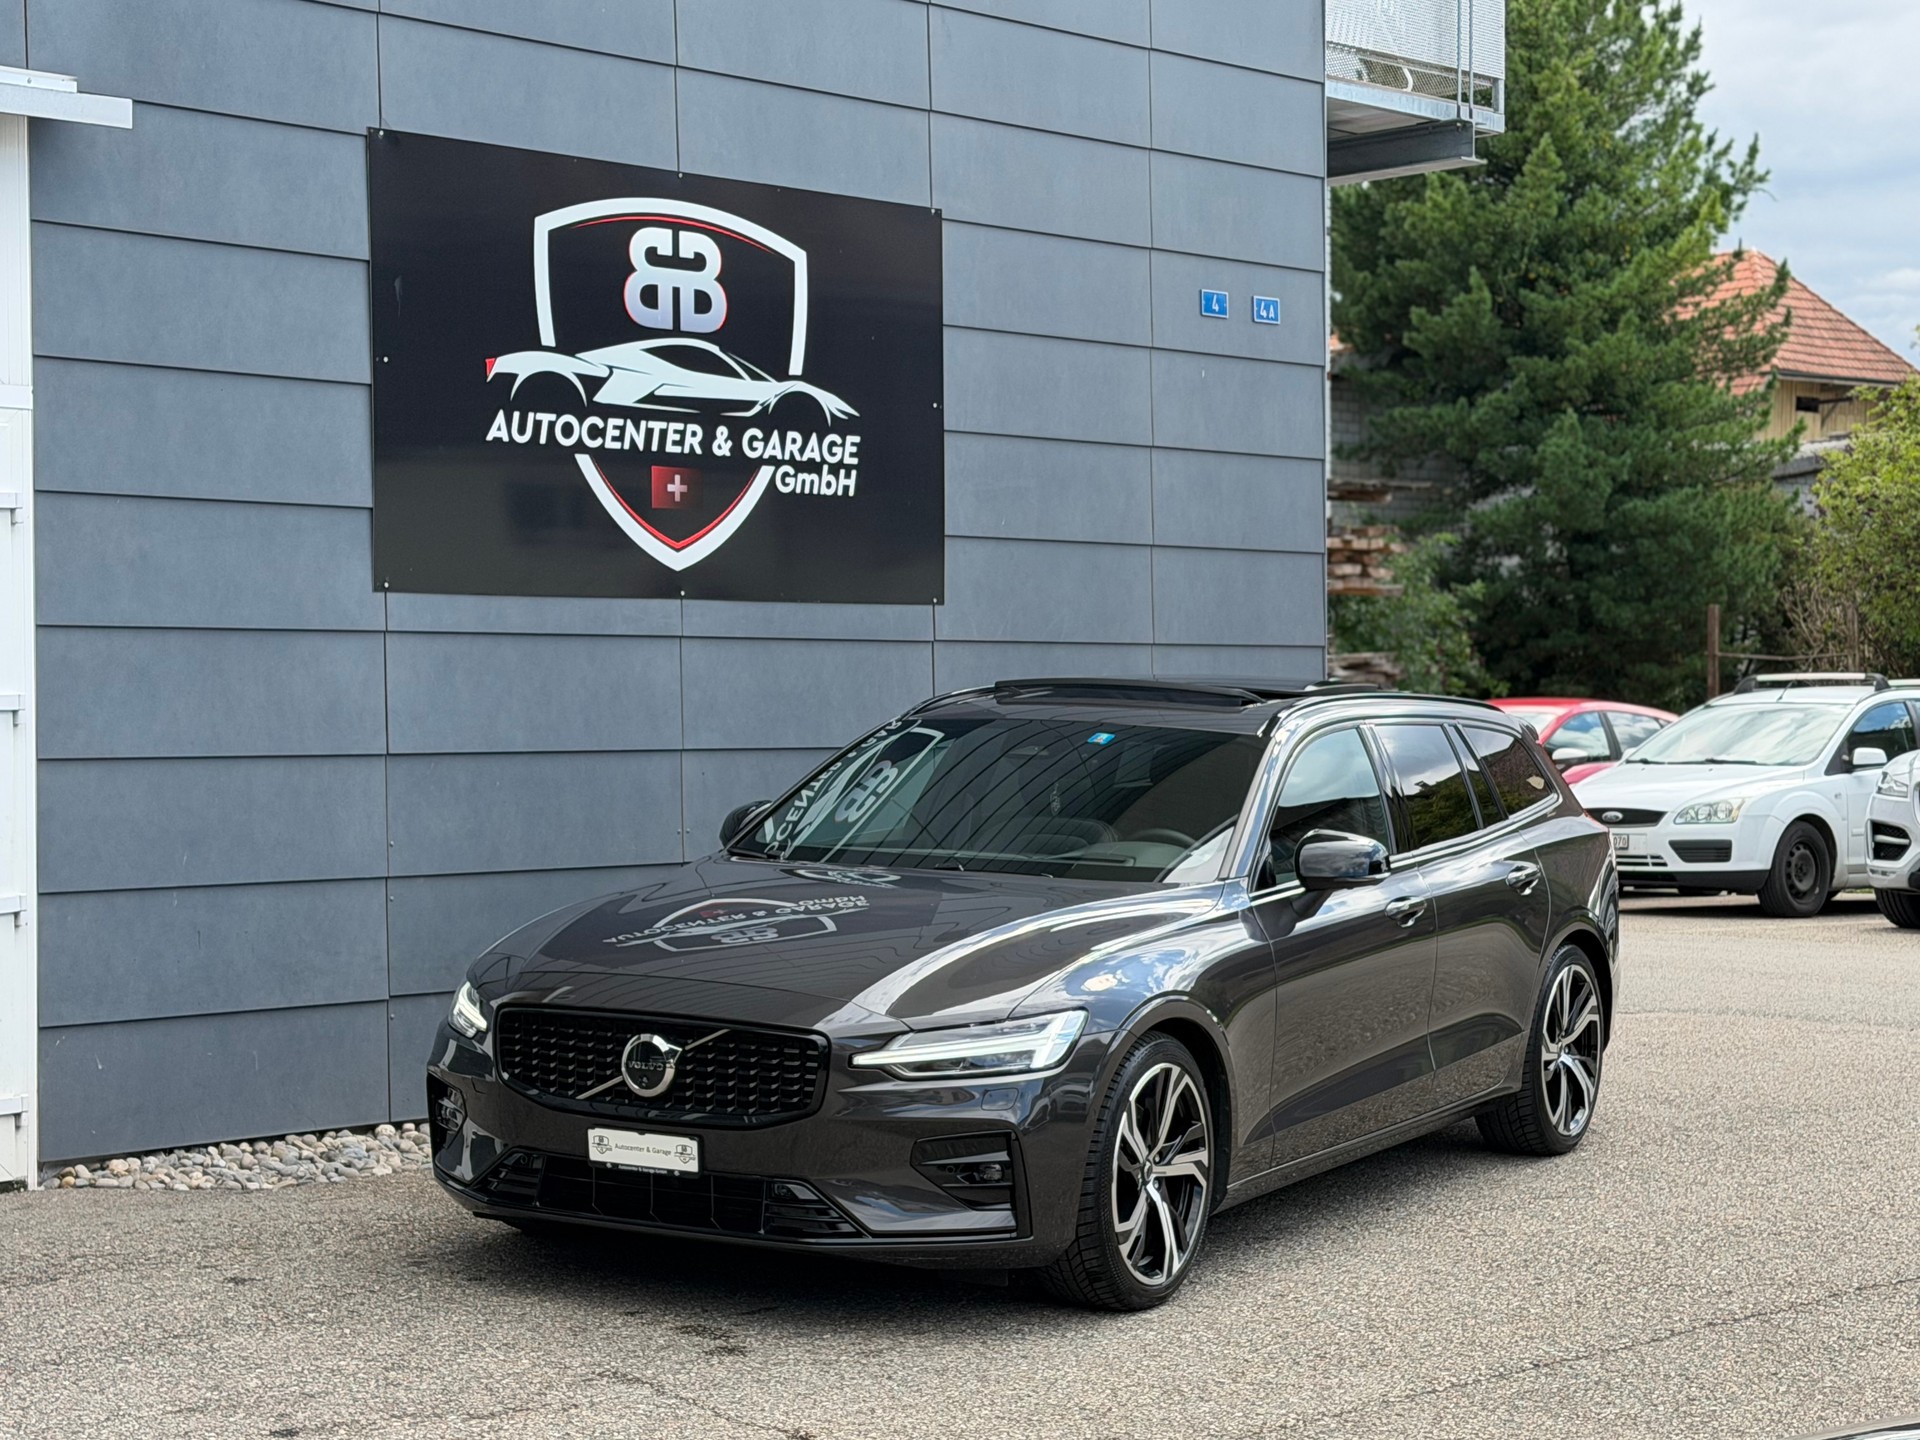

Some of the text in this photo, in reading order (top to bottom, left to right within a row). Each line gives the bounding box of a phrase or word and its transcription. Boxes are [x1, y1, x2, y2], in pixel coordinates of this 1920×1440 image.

[1211, 294, 1219, 312] 4
[1260, 301, 1275, 319] 4A
[485, 409, 861, 465] AUTOCENTER & GARAGE
[774, 465, 858, 496] GmbH
[628, 1060, 664, 1071] VOLVO
[614, 1143, 645, 1153] Autocenter
[652, 1147, 672, 1157] Garage
